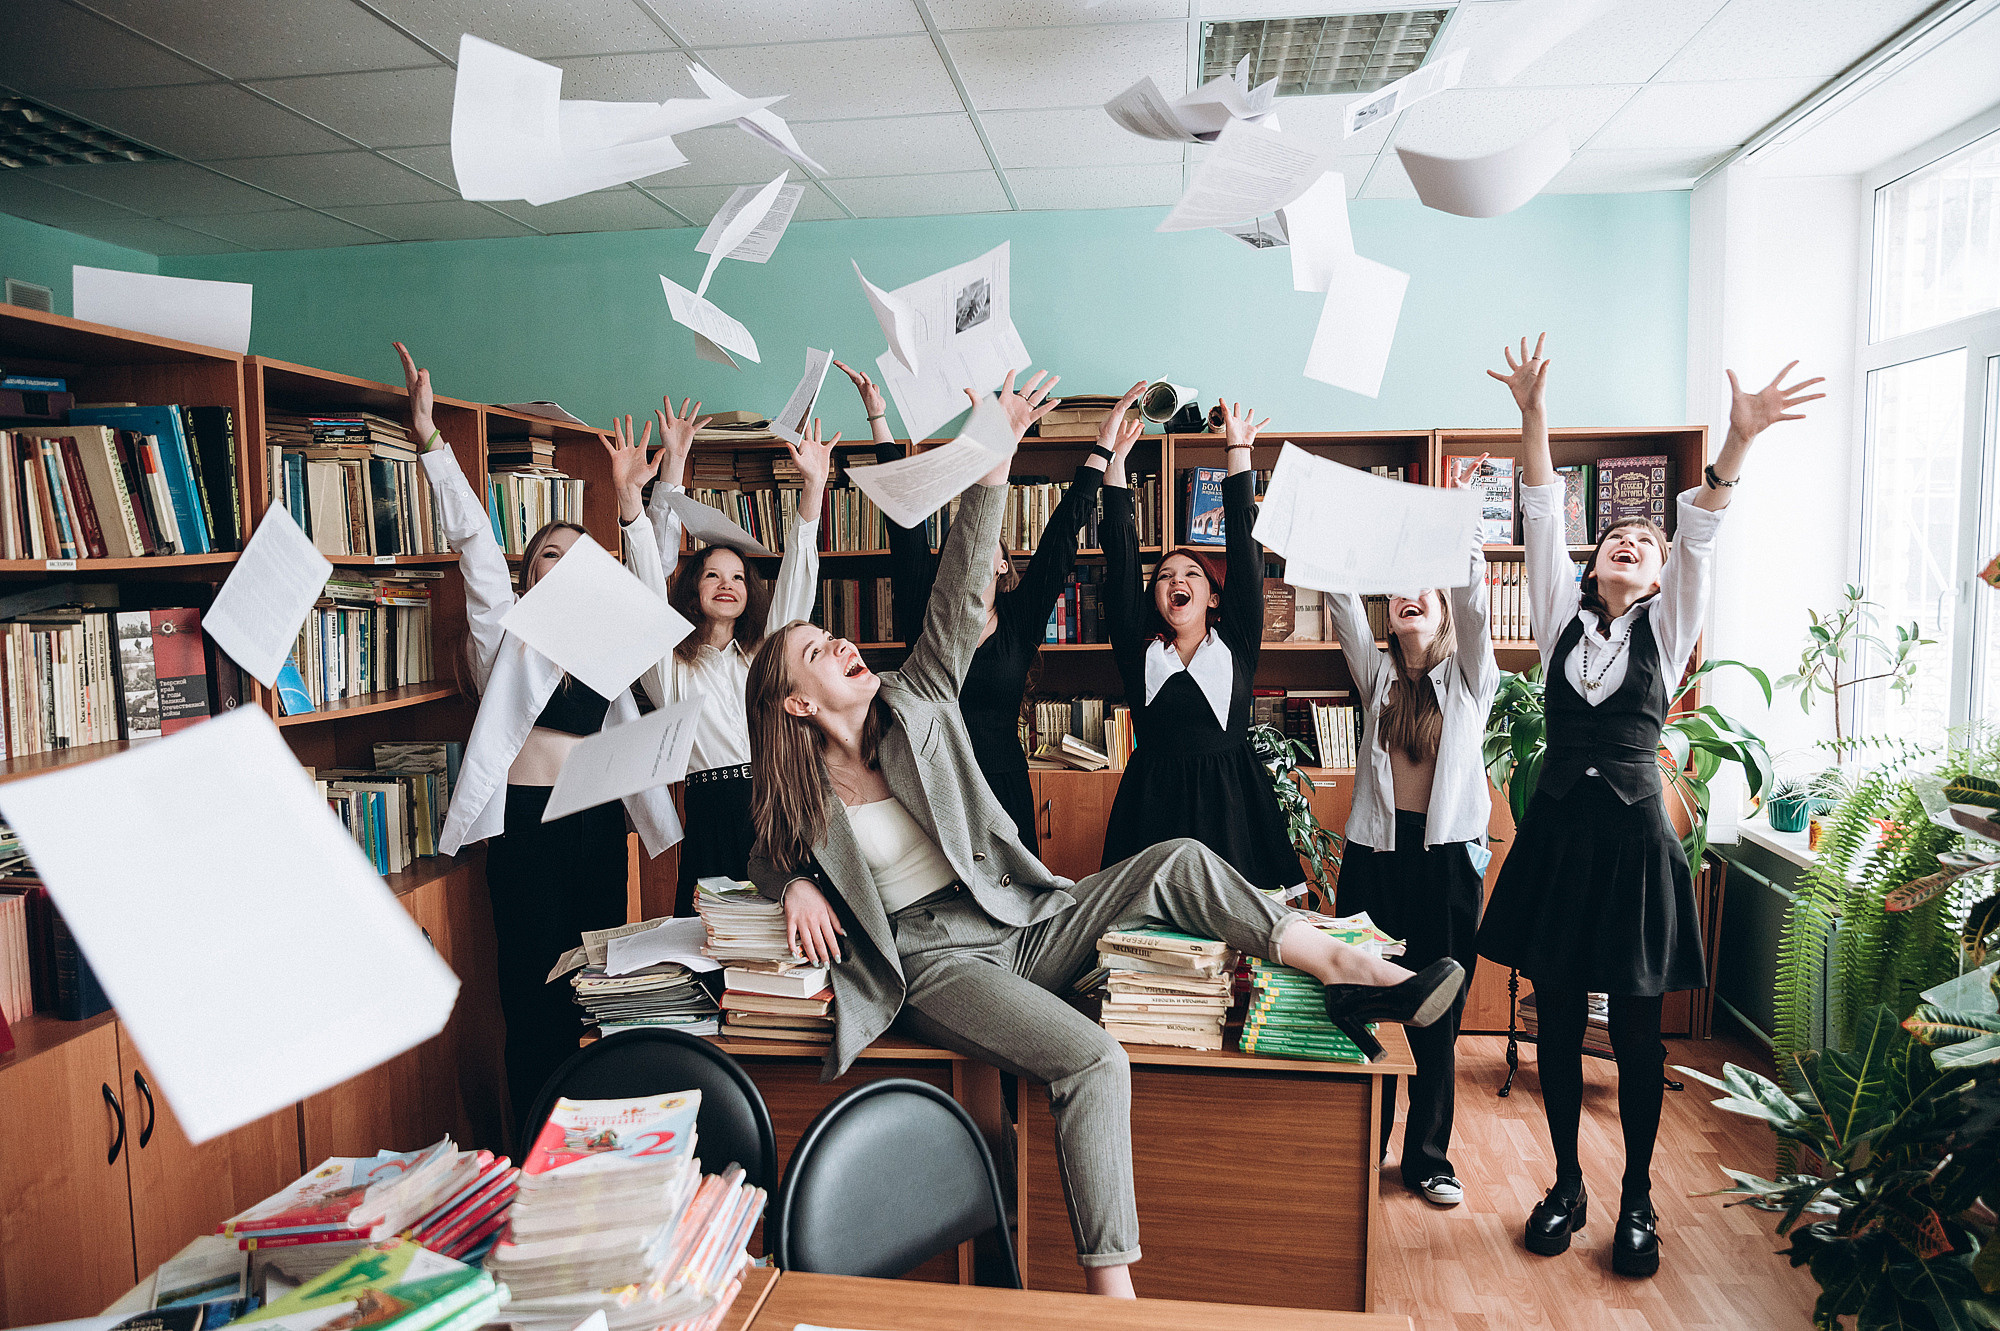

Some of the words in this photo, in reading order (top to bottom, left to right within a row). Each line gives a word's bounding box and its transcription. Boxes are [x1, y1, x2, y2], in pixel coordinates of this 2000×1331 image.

[159, 678, 187, 686] Тверской
[161, 697, 186, 705] Великой
[161, 701, 206, 711] Отечественной
[1121, 936, 1159, 947] АЛГЕБРА
[1111, 943, 1152, 958] ЛИТЕРАТУРА
[1166, 1024, 1196, 1032] БИОЛОГИЯ
[628, 1131, 676, 1158] 2
